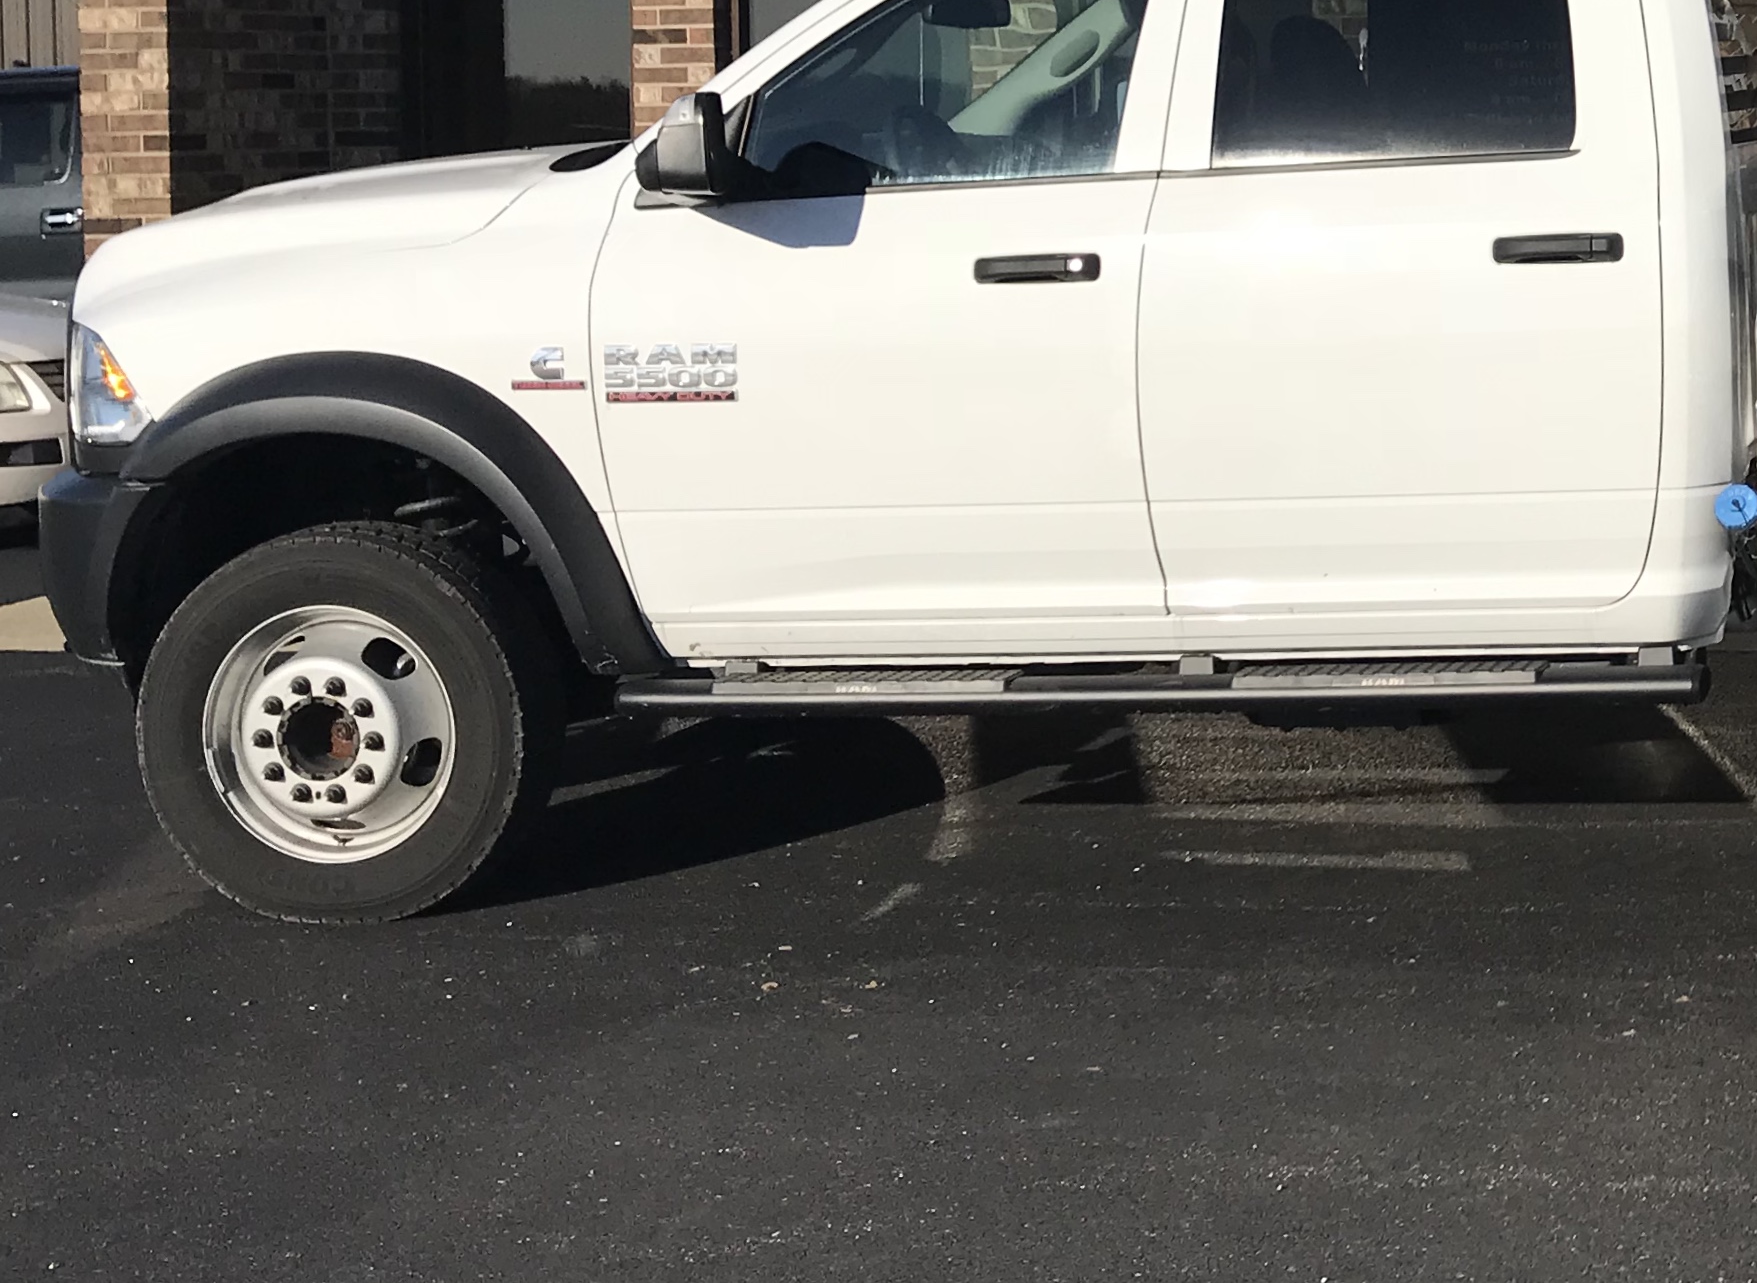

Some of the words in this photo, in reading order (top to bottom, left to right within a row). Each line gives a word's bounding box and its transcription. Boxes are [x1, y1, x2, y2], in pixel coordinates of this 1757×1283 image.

[604, 343, 738, 365] RAM
[604, 366, 738, 388] 5500
[676, 390, 734, 401] DUTY
